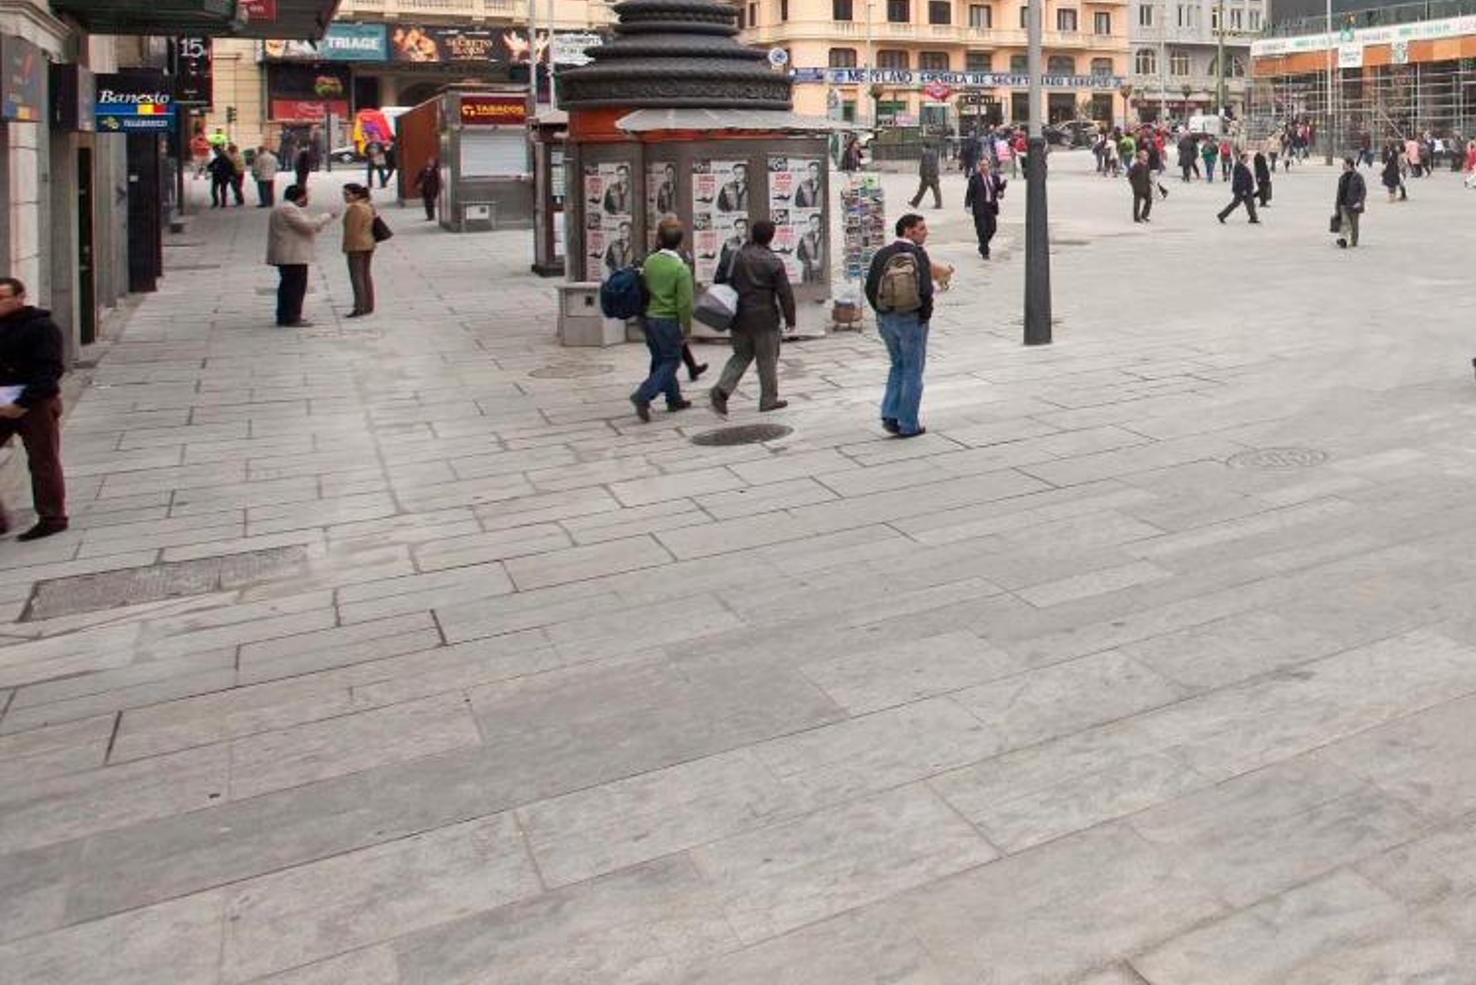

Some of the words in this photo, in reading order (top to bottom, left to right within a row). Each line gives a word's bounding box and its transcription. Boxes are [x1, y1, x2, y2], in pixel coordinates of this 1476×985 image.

[329, 36, 380, 51] TRIAGE
[99, 89, 170, 104] Banesto
[477, 103, 525, 116] TABACOS
